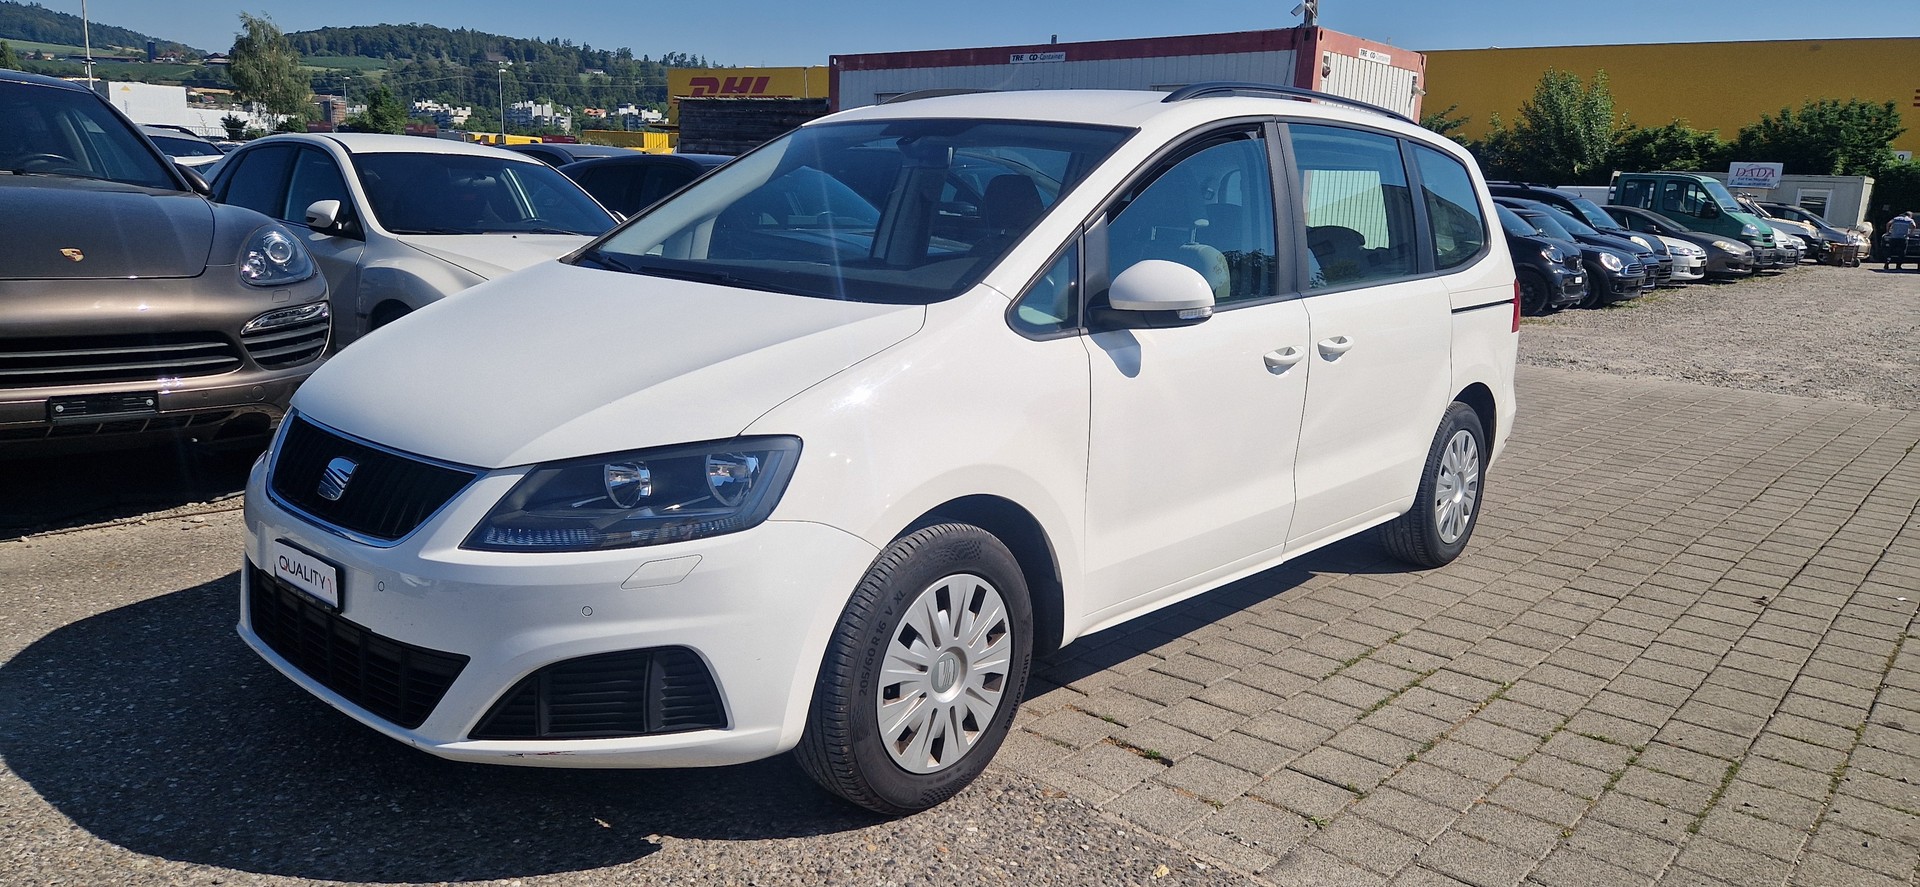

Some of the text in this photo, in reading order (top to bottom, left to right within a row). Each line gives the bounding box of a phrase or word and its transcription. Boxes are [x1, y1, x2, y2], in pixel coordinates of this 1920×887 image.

[689, 76, 791, 98] DHL
[1735, 167, 1775, 178] DADA
[859, 590, 906, 696] 205/60 R 16 V XL
